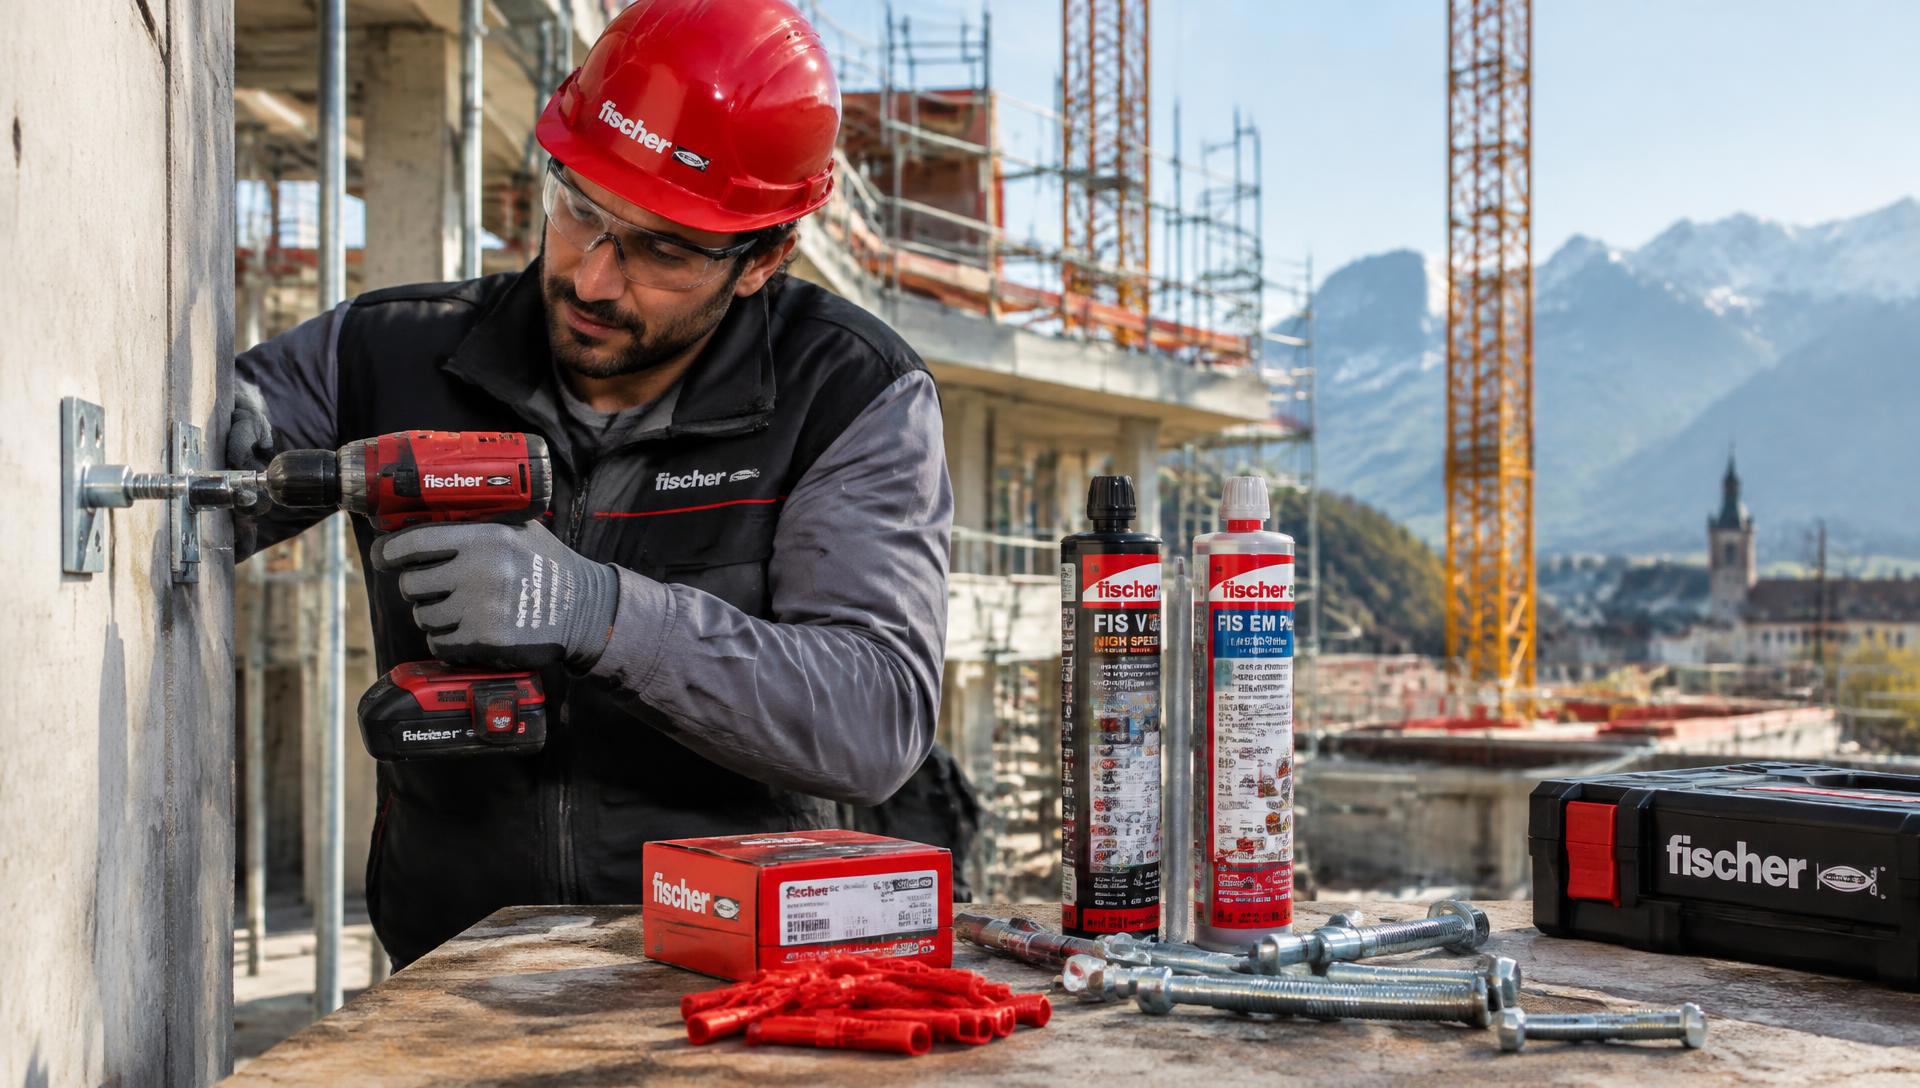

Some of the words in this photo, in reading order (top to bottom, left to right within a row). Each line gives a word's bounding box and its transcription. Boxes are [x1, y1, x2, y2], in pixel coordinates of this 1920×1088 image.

[598, 99, 672, 154] fischer
[423, 473, 483, 488] fischer
[655, 469, 726, 491] fischer
[1096, 580, 1158, 598] fischer
[1222, 580, 1287, 599] fischer
[1094, 613, 1129, 633] FIS
[1135, 613, 1147, 633] V
[1217, 614, 1243, 632] FIS
[1250, 614, 1276, 632] EM
[1666, 834, 1807, 889] fischer
[652, 871, 711, 914] fischer
